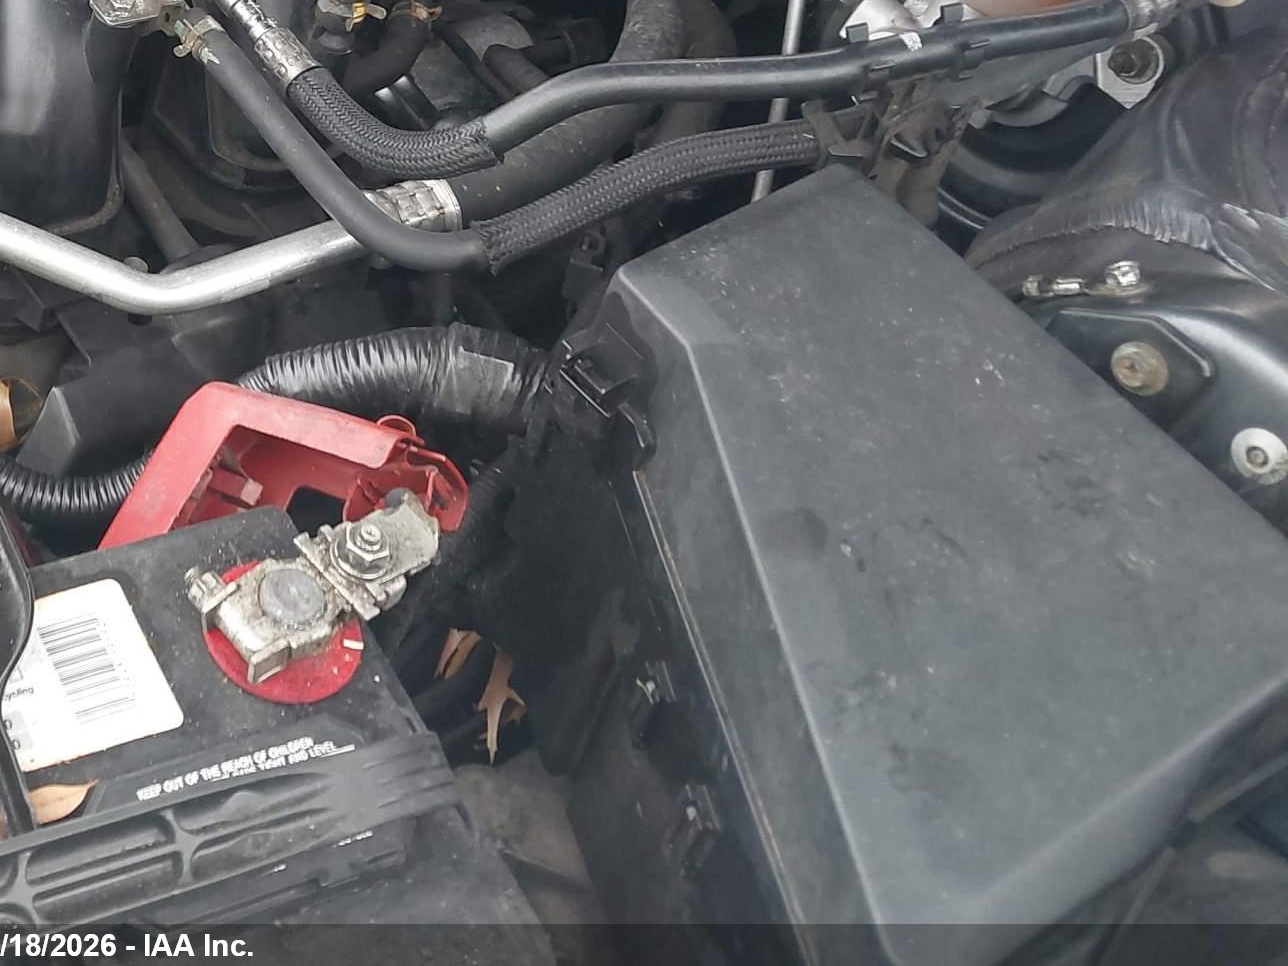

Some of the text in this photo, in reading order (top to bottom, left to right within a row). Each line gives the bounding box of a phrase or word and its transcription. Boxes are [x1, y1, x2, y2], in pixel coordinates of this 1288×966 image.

[136, 783, 162, 802] KEEP
[163, 776, 185, 793] OUT
[185, 770, 200, 786] OF
[200, 764, 222, 782] THE
[220, 755, 254, 777] REACH
[254, 748, 268, 764] OF
[268, 736, 314, 759] CHILDREN
[309, 740, 337, 758] LEVEL
